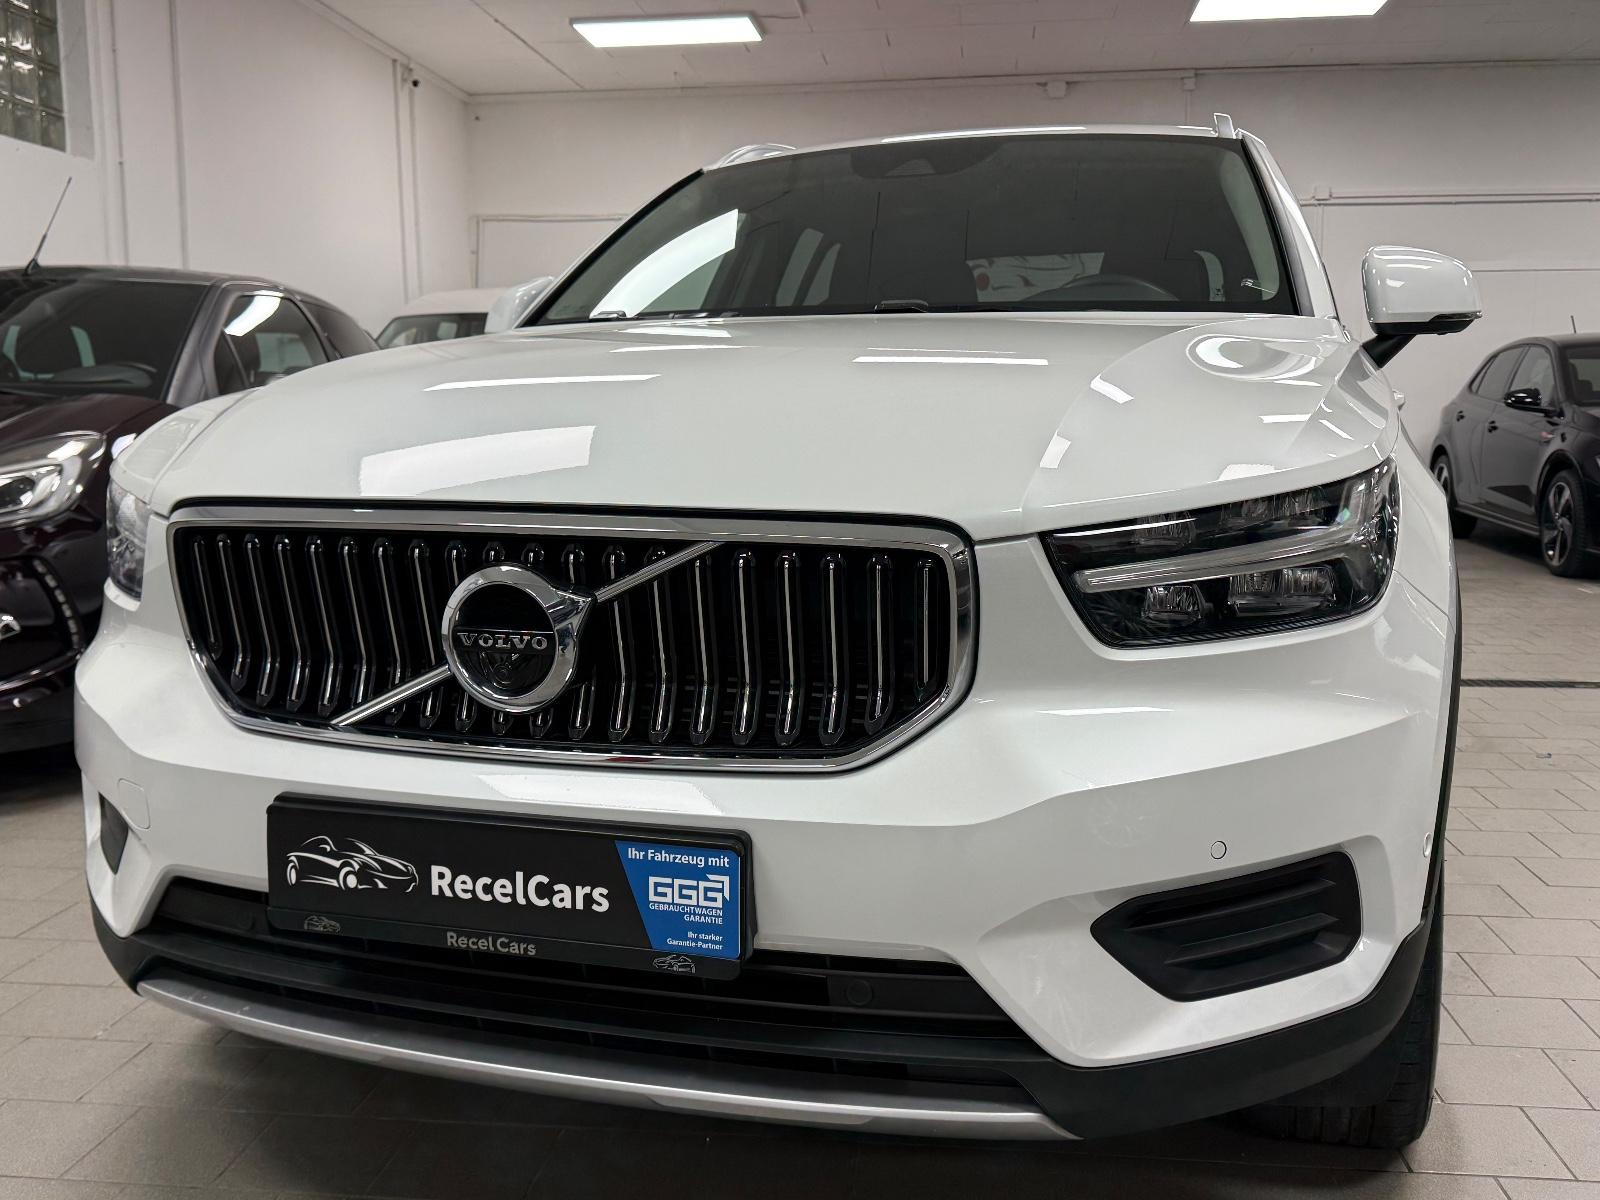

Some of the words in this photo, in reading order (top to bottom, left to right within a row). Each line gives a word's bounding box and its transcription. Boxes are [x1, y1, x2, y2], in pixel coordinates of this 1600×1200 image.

[456, 632, 548, 650] VOLVO
[628, 847, 645, 860] Ihr
[647, 849, 705, 868] Fahrzeug
[708, 855, 729, 867] mit
[430, 864, 610, 913] RecelCars
[648, 875, 724, 908] GGG
[648, 902, 723, 916] GEBRAUCHTWAGEN
[683, 914, 723, 925] GARANTIE
[666, 938, 723, 950] Garantie-Partner
[687, 931, 698, 939] Ihr
[698, 932, 723, 942] starker
